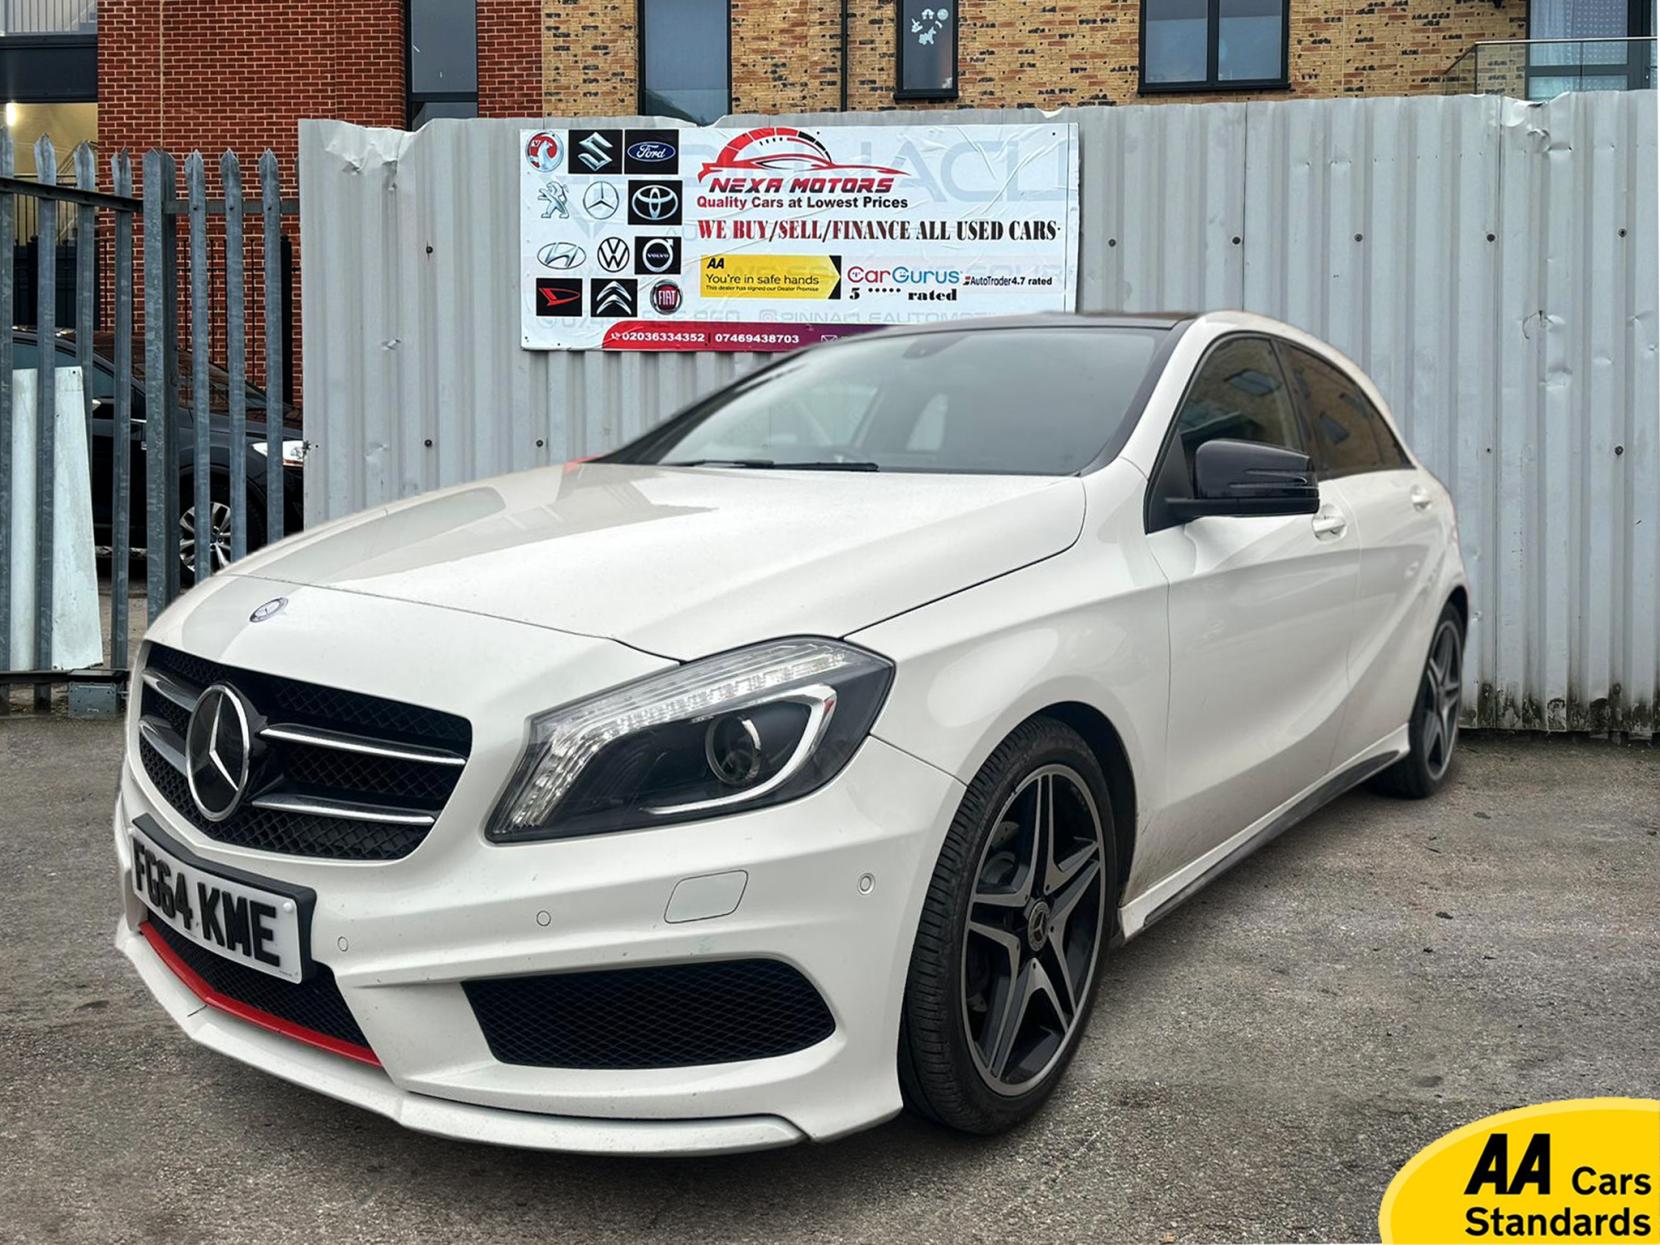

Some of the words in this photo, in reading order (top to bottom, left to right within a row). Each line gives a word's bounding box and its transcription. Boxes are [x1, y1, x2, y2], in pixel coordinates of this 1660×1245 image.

[636, 145, 665, 158] Ford
[709, 178, 781, 193] NEXA
[789, 178, 895, 193] MOTORS
[697, 197, 747, 210] Quality
[752, 197, 784, 208] Cars
[789, 198, 803, 208] at
[807, 197, 859, 208] Lowest
[863, 197, 908, 209] Prices
[698, 220, 726, 240] WE
[915, 220, 952, 240] ALL
[956, 221, 1004, 241] USED
[1009, 220, 1057, 241] CARS
[707, 258, 724, 269] AA
[706, 274, 741, 284] You're
[744, 274, 754, 284] in
[758, 274, 781, 284] safe
[784, 275, 819, 285] hands
[847, 266, 960, 284] CarGurus
[1028, 277, 1052, 286] rated
[658, 290, 676, 307] FIAT
[849, 288, 860, 300] 5
[908, 289, 957, 301] rated
[622, 333, 705, 341] 02036334352
[715, 333, 800, 343] 07469438703
[198, 882, 280, 967] KME
